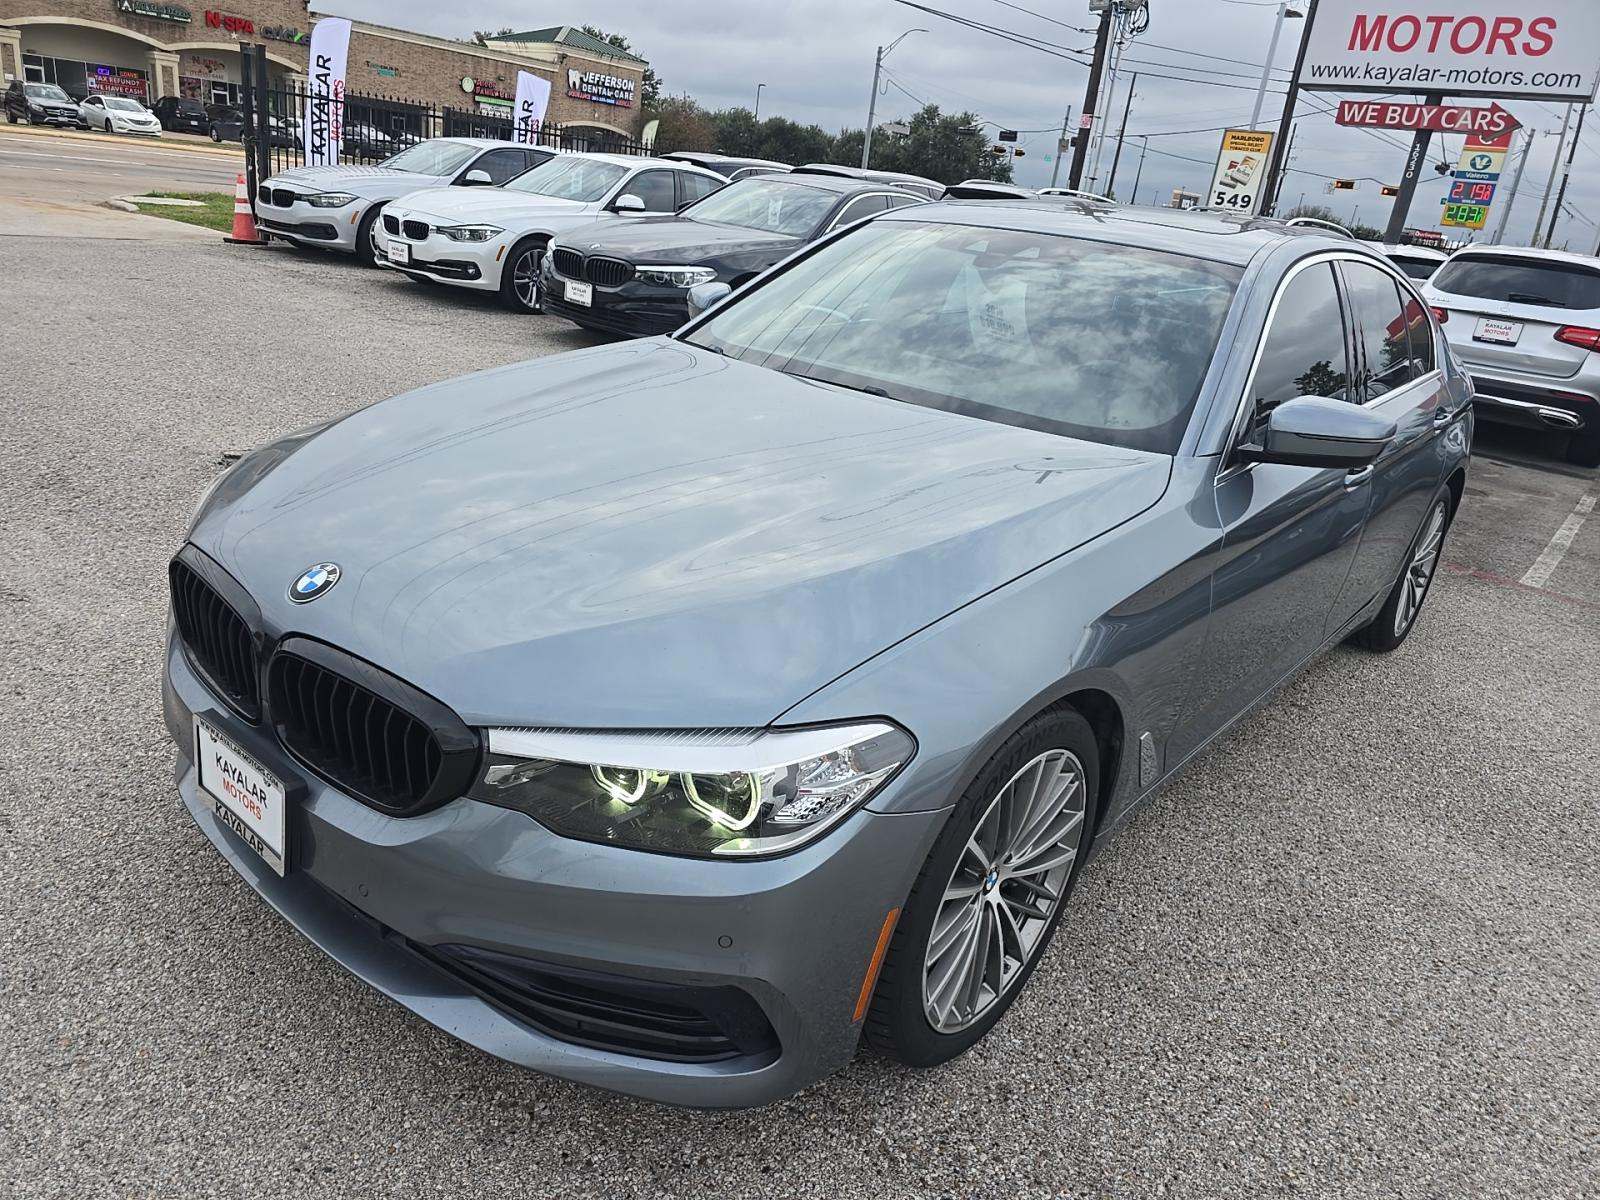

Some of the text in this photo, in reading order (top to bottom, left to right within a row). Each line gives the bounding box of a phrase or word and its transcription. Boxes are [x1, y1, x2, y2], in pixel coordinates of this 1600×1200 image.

[224, 16, 255, 33] SPA
[1347, 15, 1557, 57] MOTORS
[105, 84, 124, 92] HAVE
[124, 87, 143, 95] CASH
[109, 77, 140, 86] REFUND?
[582, 72, 635, 91] JEFFERSON
[1311, 62, 1581, 88] www.kayalar-motors.com
[311, 54, 331, 156] KAYALAR
[582, 84, 610, 96] DENTAL
[614, 90, 634, 101] CARE
[331, 79, 344, 142] MOTORS
[1344, 103, 1508, 132] WE BUY CARS
[1406, 143, 1420, 178] 16230
[1485, 323, 1513, 331] KAYALAR
[215, 751, 268, 808] KAYALAR
[223, 777, 262, 820] MOTORS
[215, 801, 264, 857] KAYALAR
